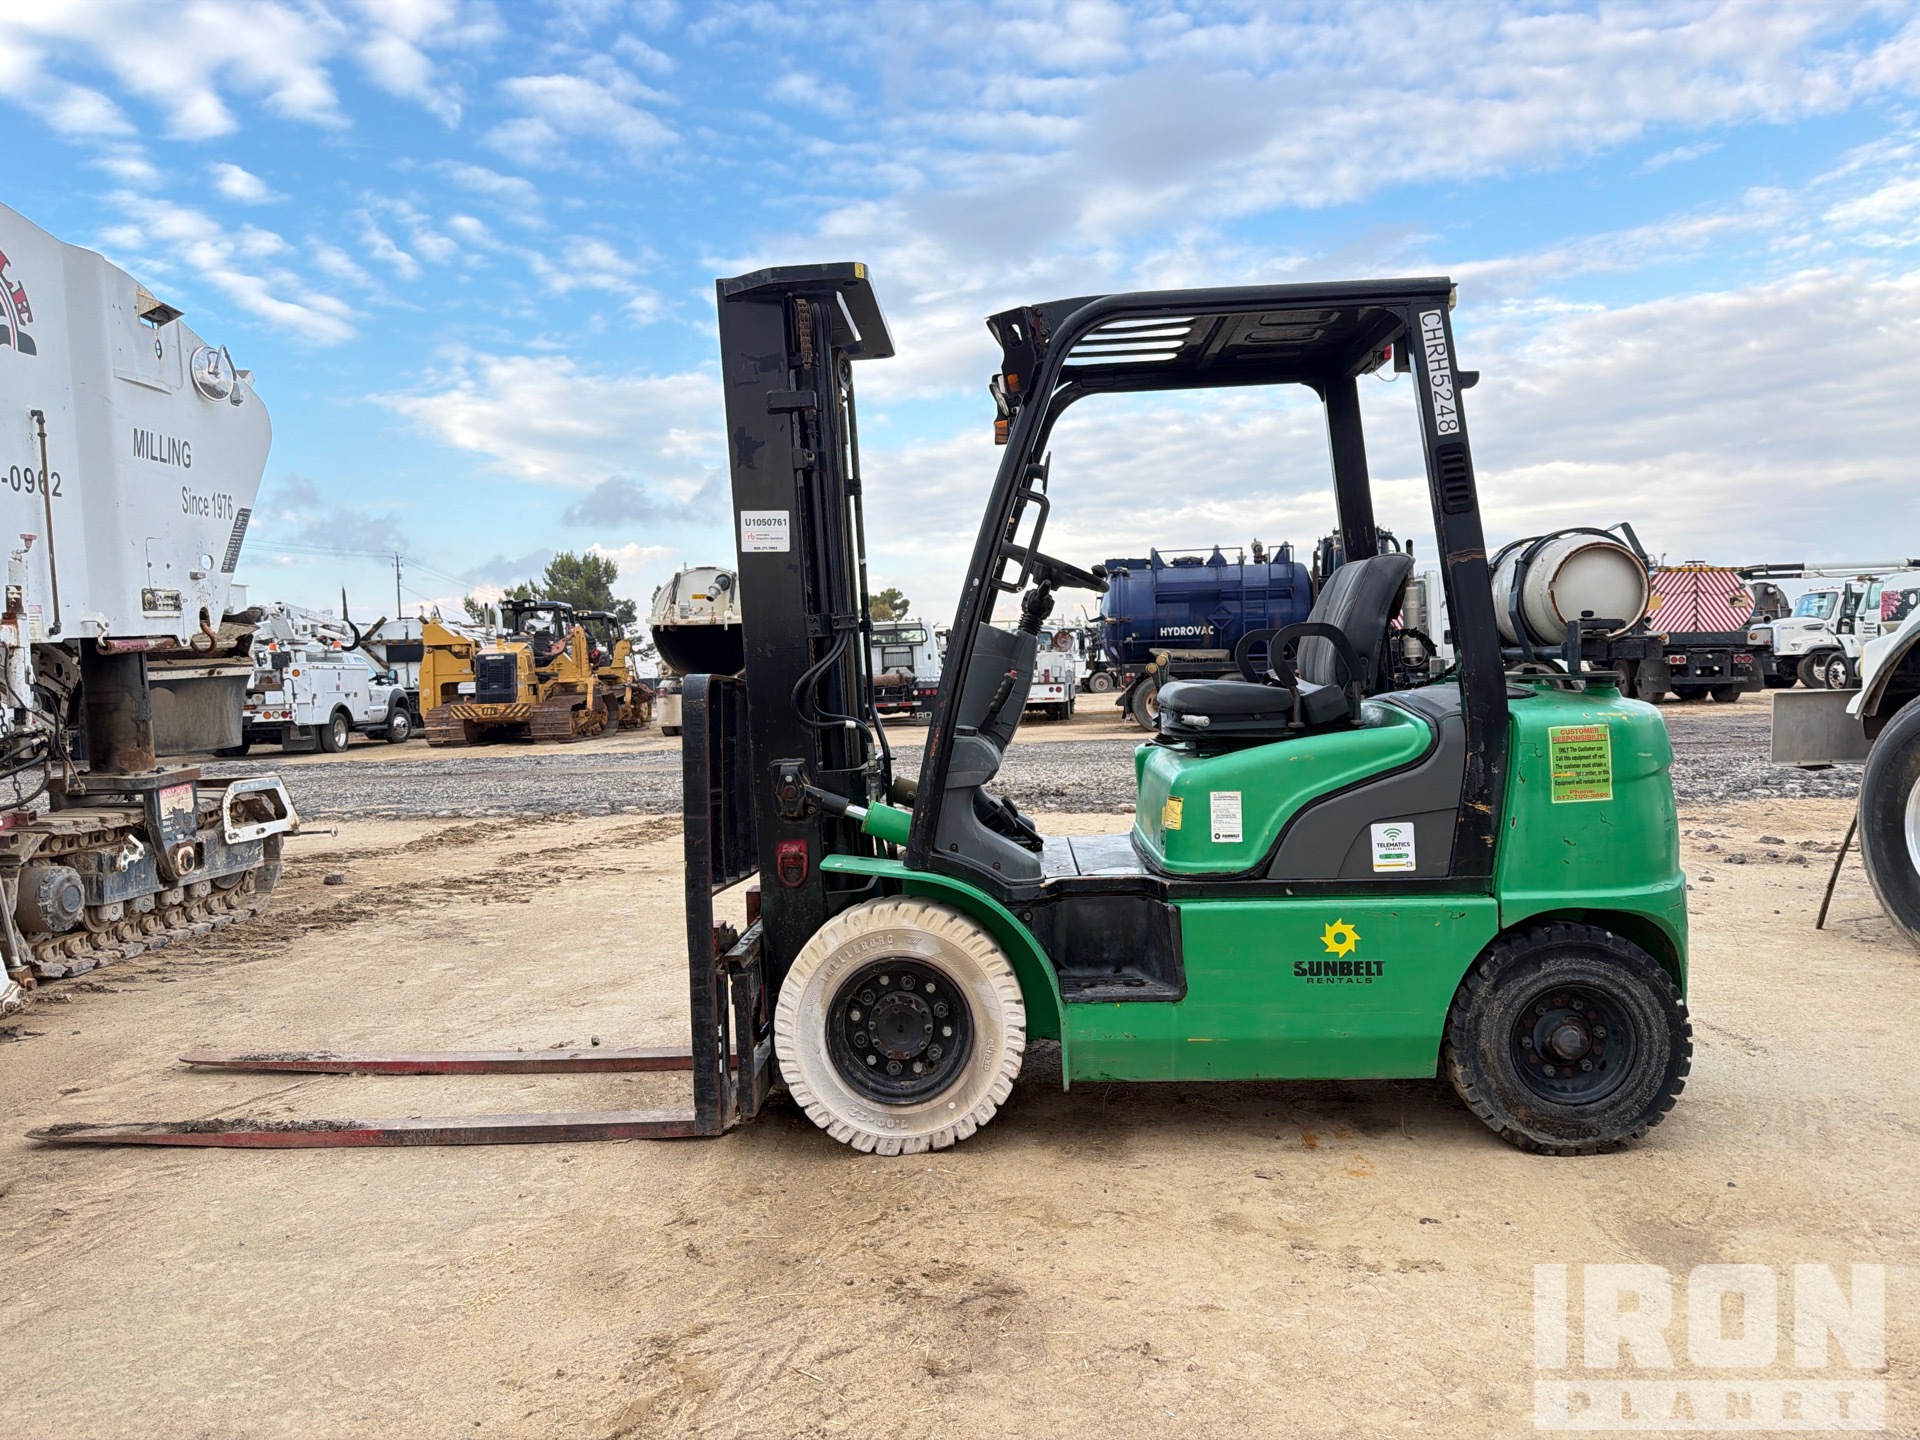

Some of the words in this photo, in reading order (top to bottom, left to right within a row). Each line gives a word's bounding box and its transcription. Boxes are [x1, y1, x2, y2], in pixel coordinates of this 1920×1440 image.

[1421, 312, 1458, 433] CHRH5248
[133, 428, 192, 468] MILLING
[181, 486, 209, 517] Since
[212, 492, 233, 520] 1976
[745, 518, 787, 526] U1050761
[1160, 625, 1214, 637] HYDROVAC
[1560, 727, 1599, 735] CUSTOMER
[1552, 734, 1607, 743] RESPONSIBILITY
[1555, 779, 1575, 787] Equipment
[1293, 961, 1385, 976] SUNBELT
